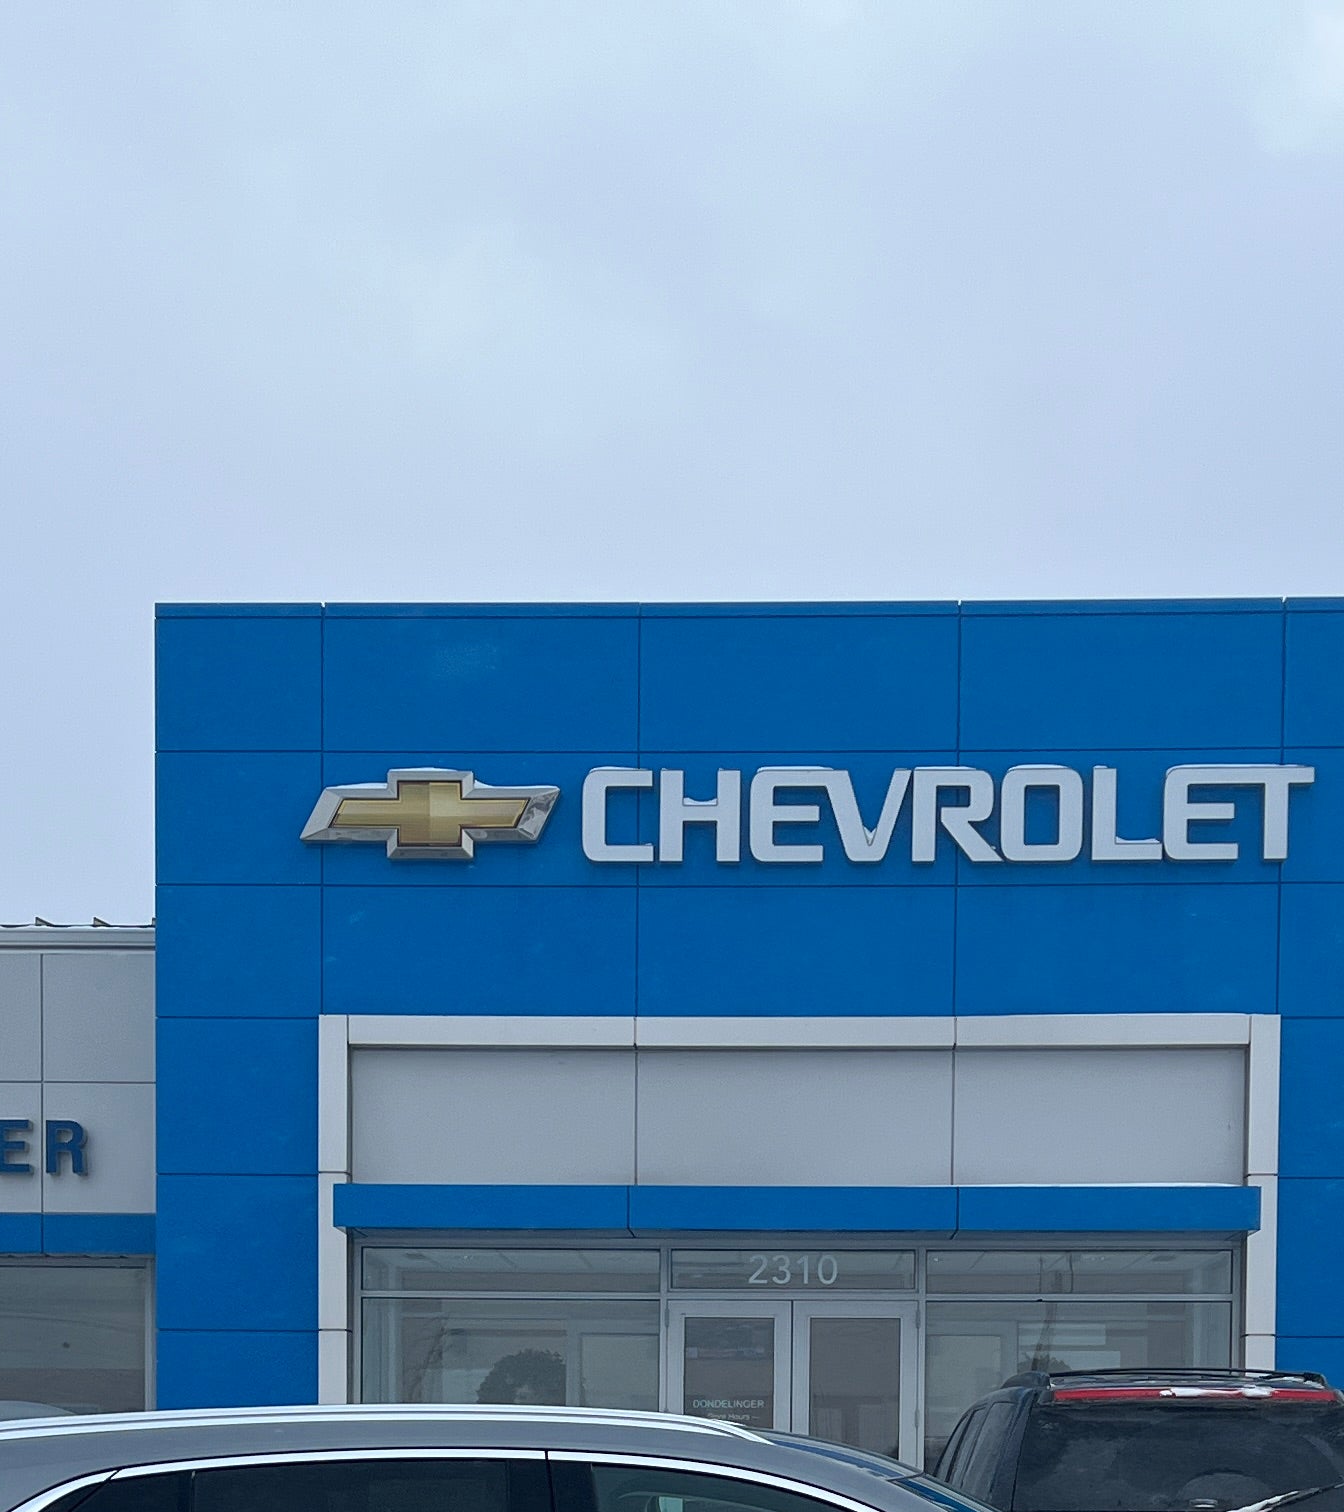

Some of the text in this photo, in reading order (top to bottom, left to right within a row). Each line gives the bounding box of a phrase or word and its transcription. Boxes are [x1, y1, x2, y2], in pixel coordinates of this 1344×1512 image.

[580, 765, 1317, 864] CHEVROLET
[747, 1254, 838, 1285] 2310
[692, 1399, 765, 1409] DONDELINGER
